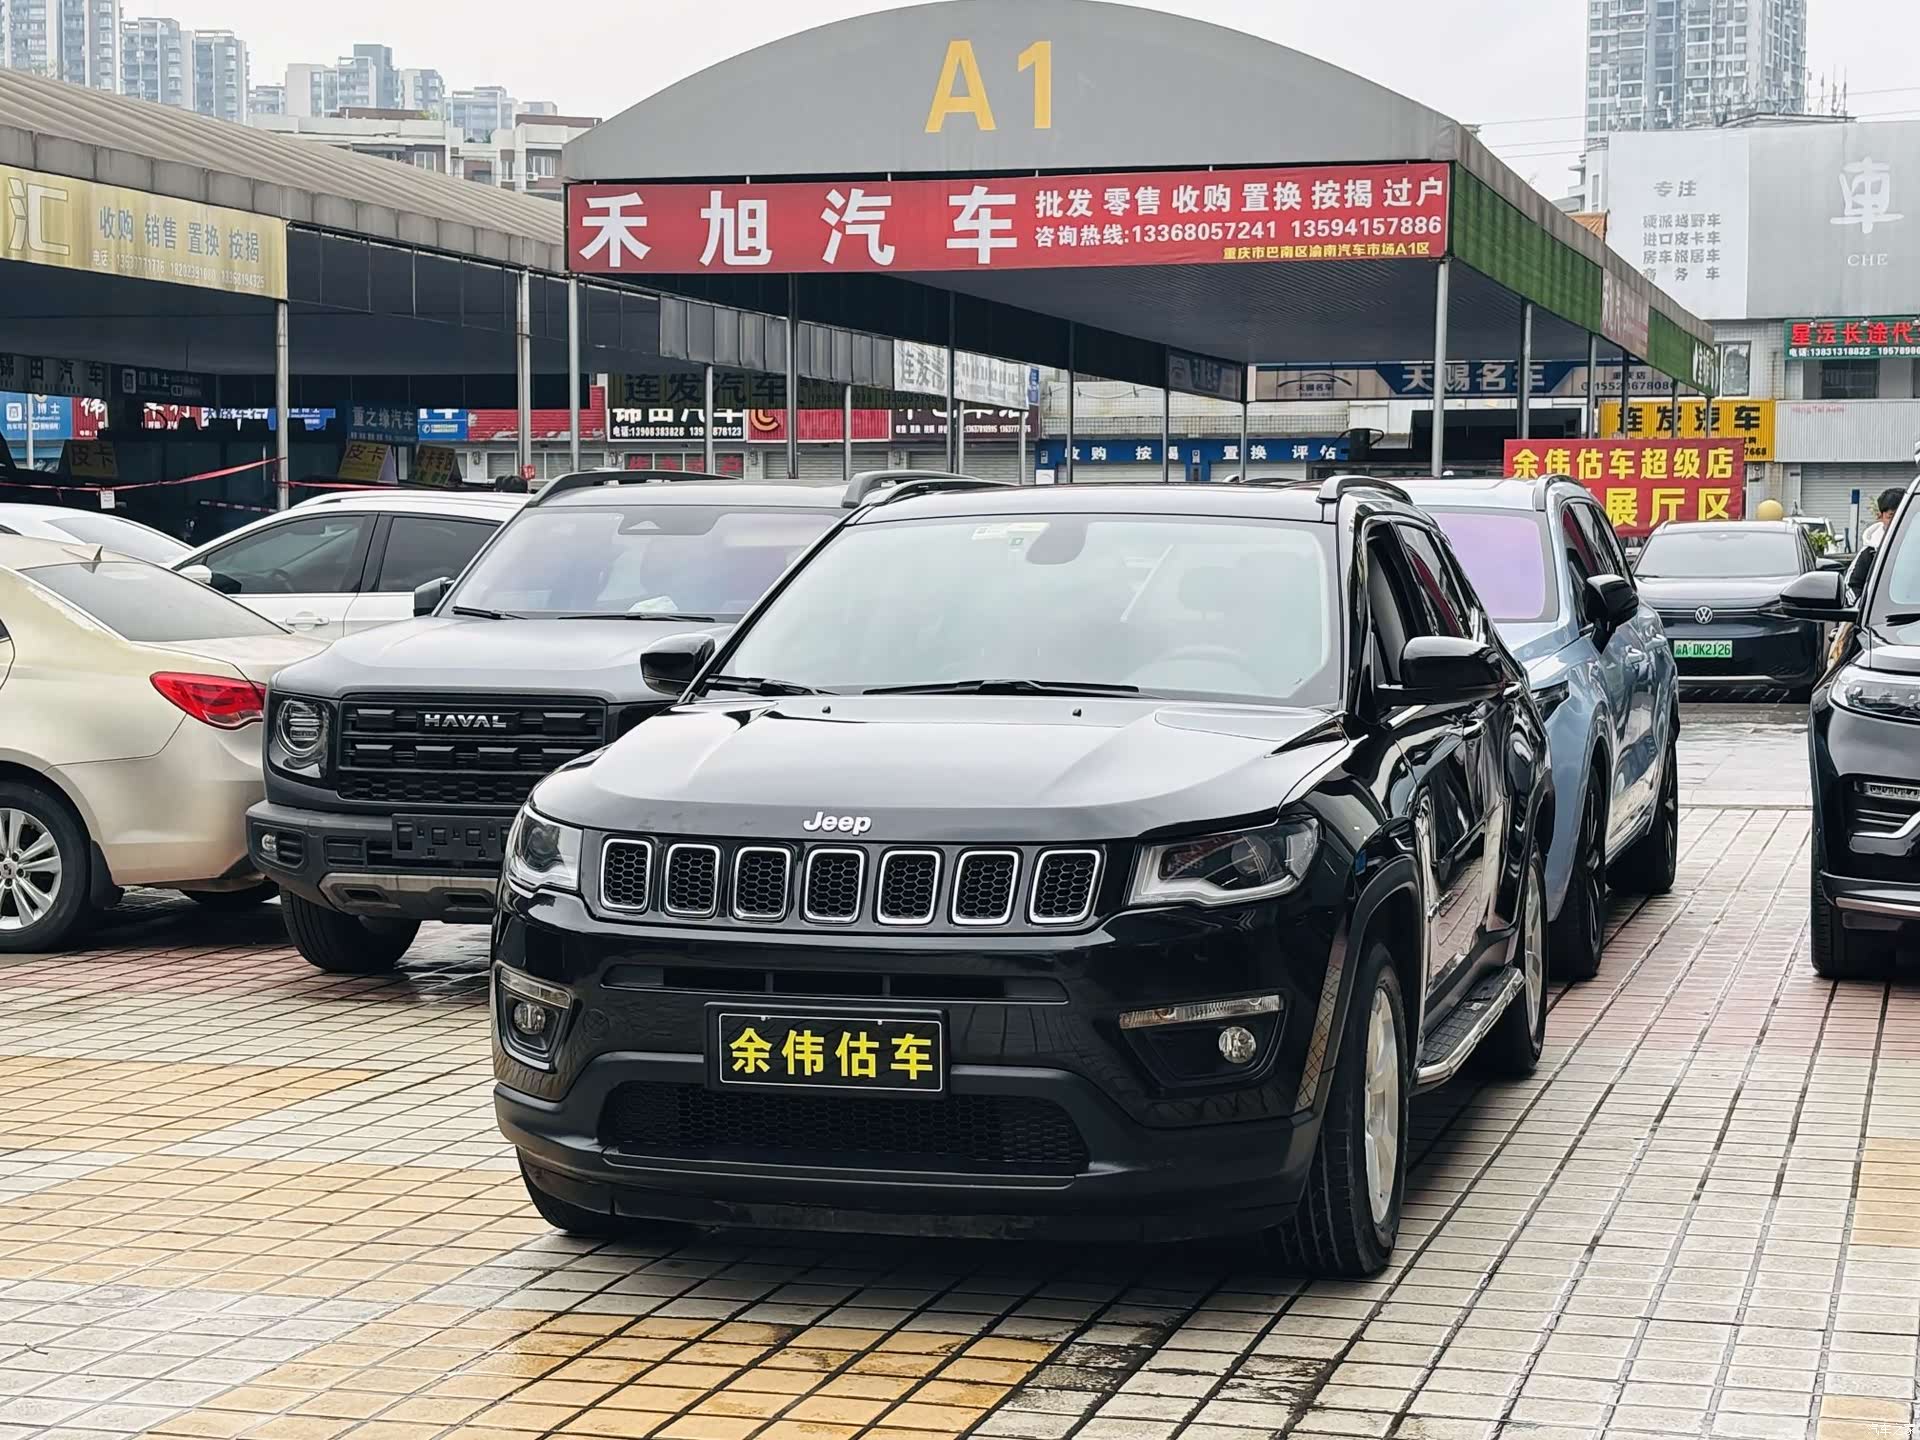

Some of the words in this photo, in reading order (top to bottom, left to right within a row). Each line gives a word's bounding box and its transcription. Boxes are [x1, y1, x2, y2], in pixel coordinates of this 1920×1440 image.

[1036, 189, 1093, 218] 批发
[1104, 186, 1161, 216] 零售
[1172, 184, 1231, 214] 收购
[1242, 181, 1302, 211] 置换
[1312, 179, 1372, 209] 按揭
[1383, 177, 1443, 208] 过户
[1653, 180, 1697, 197] 专注
[8, 177, 70, 256] 汇
[1643, 213, 1721, 229] 硬派越野车
[100, 207, 134, 242] 收购
[145, 214, 177, 250] 销售
[188, 222, 220, 256] 置换
[229, 229, 260, 263] 按揭
[579, 186, 1018, 267] 禾旭汽车
[1291, 216, 1442, 240] 13594157886
[1643, 231, 1721, 246] 进口皮卡车
[1223, 241, 1430, 260] 重庆市巴南区渝南汽车市场A1区
[1643, 248, 1721, 264] 房车旅居车
[1847, 253, 1889, 266] CHE
[690, 426, 742, 437] 139878123
[1222, 445, 1267, 460] 置换
[1512, 448, 1734, 480] 余伟估车超级店
[424, 714, 507, 728] HAVAL
[803, 811, 872, 836] Jeep
[729, 1027, 934, 1081] 余伟估车
